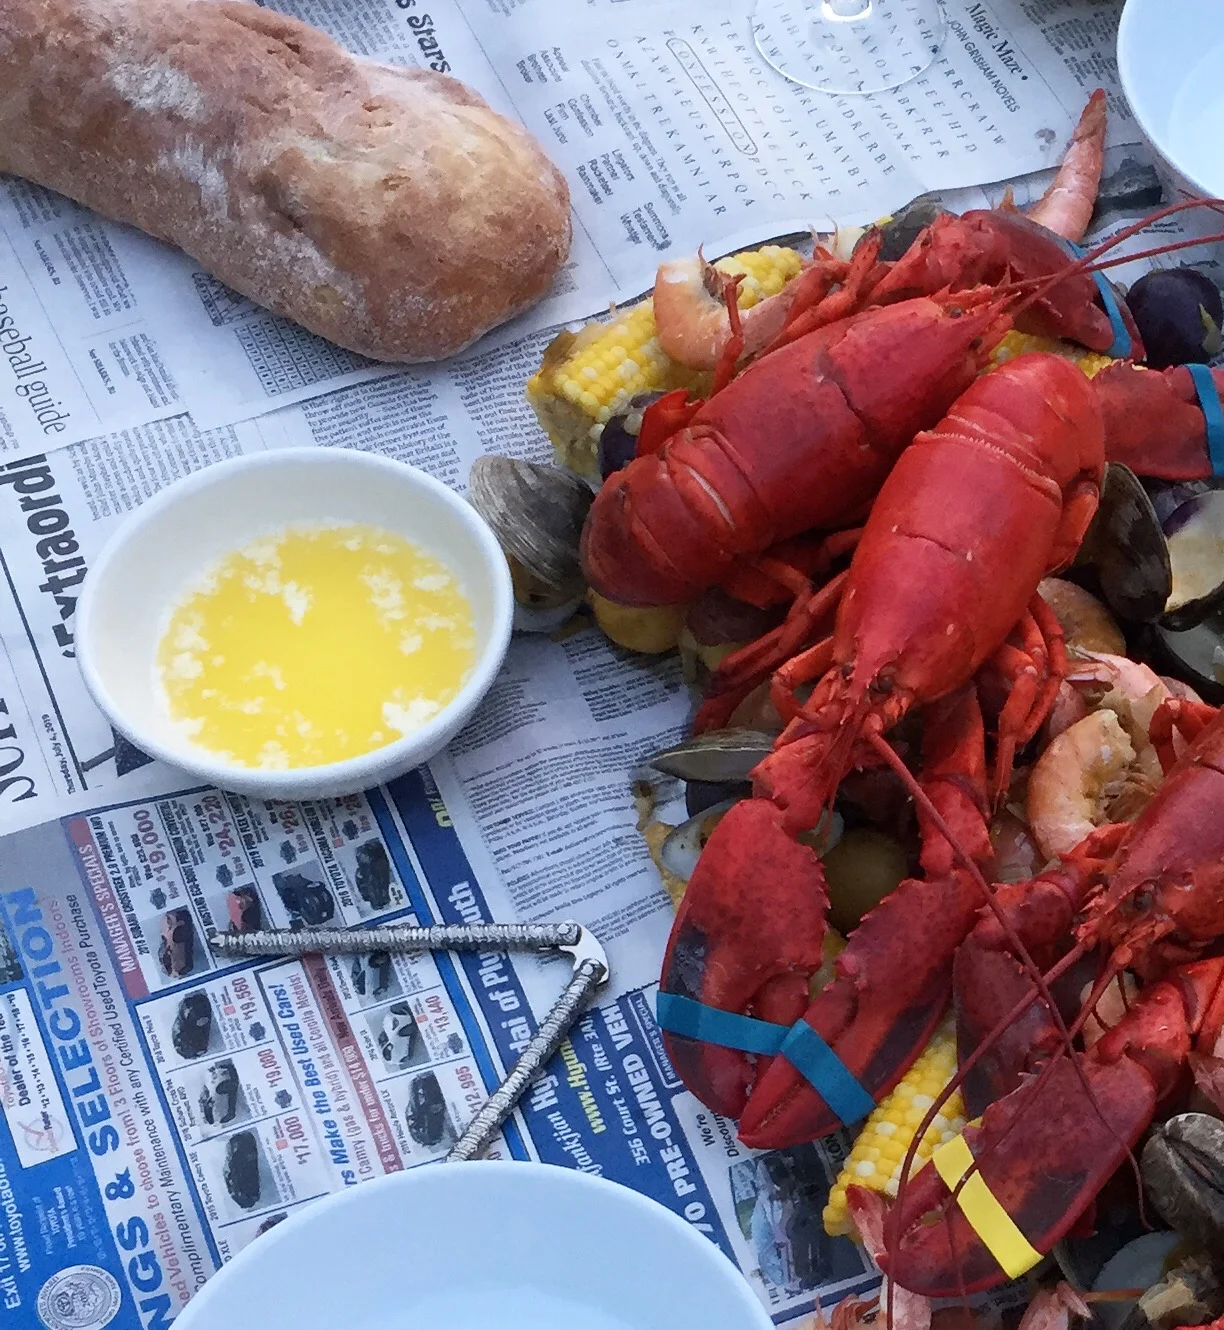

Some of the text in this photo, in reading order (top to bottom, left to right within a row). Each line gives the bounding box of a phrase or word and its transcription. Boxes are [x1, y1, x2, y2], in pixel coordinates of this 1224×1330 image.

[406, 10, 451, 73] Stars
[945, 14, 1020, 115] JOHN GRISHAM NOVELS
[963, 0, 1025, 78] Magic Maze
[14, 376, 73, 435] guide
[41, 712, 76, 794] Thursday, July 2019
[132, 805, 174, 883] $19,000
[201, 792, 238, 858] $24,220
[77, 841, 137, 974] MANAGER'S SPECIALS
[5, 881, 123, 1159] SELECTION
[63, 892, 176, 1189] Maintenance with any Certified Used Toyota Purchase
[0, 1033, 32, 1107] Dealer of the
[256, 1046, 284, 1089] $19,000
[267, 981, 349, 1168] Make the Best Used Cars!
[587, 1039, 650, 1166] 356 Court St. (Rte
[64, 954, 183, 1280] Vehicles to choose 3 Floors of Showrooms
[339, 1113, 373, 1176] Camry (gas
[620, 1051, 697, 1197] PRE-OWNED
[100, 1166, 137, 1204] &
